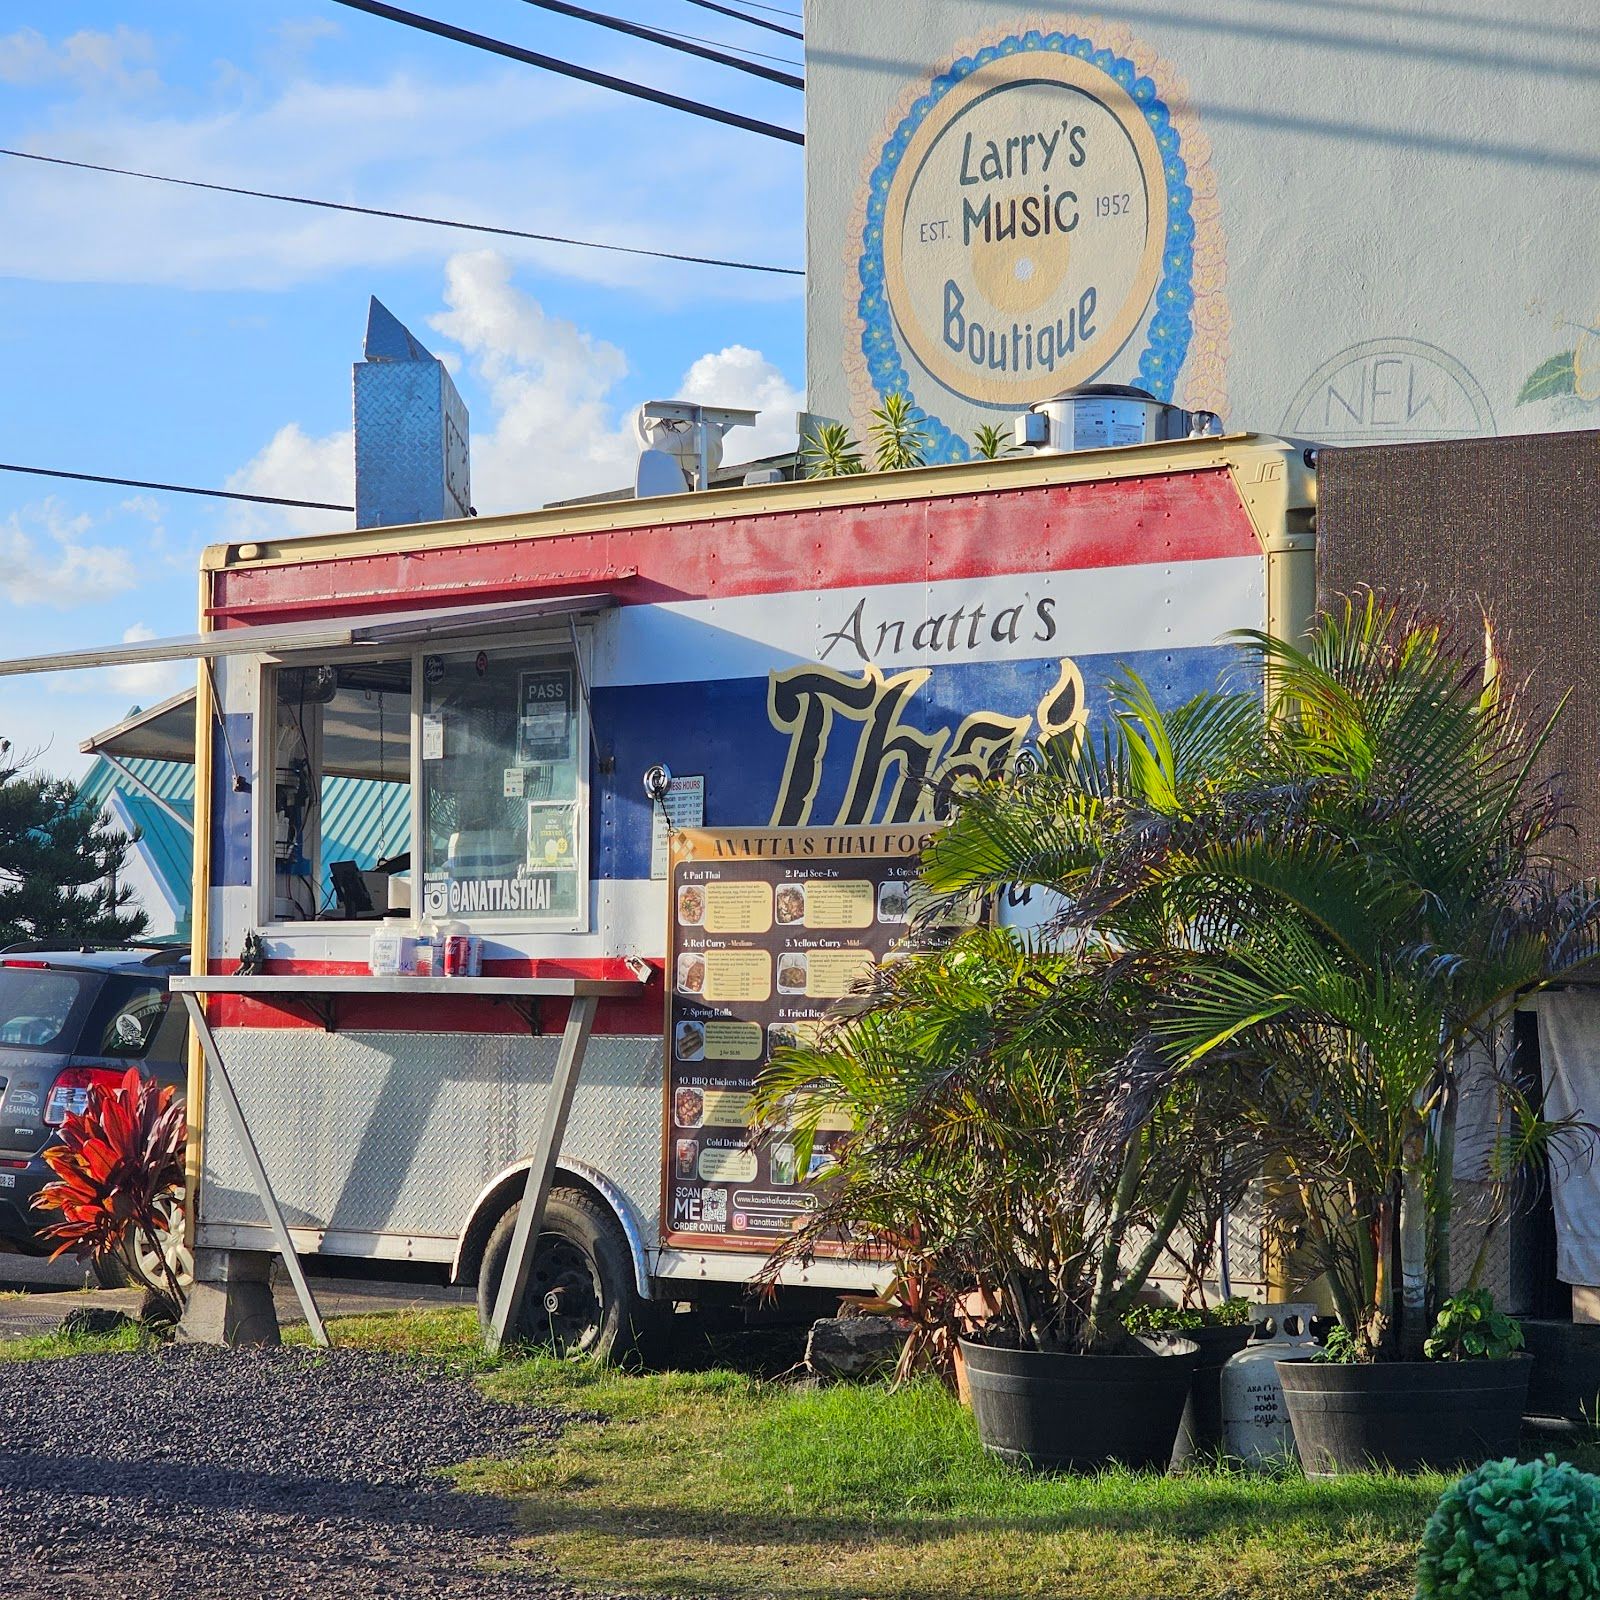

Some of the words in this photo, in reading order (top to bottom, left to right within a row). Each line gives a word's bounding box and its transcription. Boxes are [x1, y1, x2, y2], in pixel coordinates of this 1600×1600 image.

[959, 119, 1087, 187] Larry's
[1096, 193, 1131, 218] 1952
[961, 184, 1080, 246] Music
[919, 219, 952, 244] EST.
[943, 279, 1097, 373] Boutique
[821, 592, 1057, 661] Anatta's
[528, 683, 564, 698] PASS
[712, 837, 815, 857] ANATTA'S
[824, 835, 875, 854] THAI
[689, 870, 703, 880] Pad
[704, 870, 721, 880] Thai
[793, 869, 809, 878] Pad
[450, 878, 551, 913] @ANATTASTHAI
[690, 938, 705, 948] Red
[705, 938, 726, 949] Curry
[793, 938, 818, 948] Yellow
[818, 938, 842, 949] Curry
[690, 1007, 713, 1018] Spring
[713, 1007, 733, 1017] Rolls
[787, 1008, 807, 1018] Fried
[691, 1077, 709, 1087] BBQ
[709, 1077, 737, 1087] Chicken
[4, 1104, 40, 1117] SEAHAWKS
[706, 1137, 723, 1147] Cold
[723, 1138, 749, 1149] Drinks
[675, 1187, 700, 1198] SCAN
[674, 1198, 701, 1220] ME
[673, 1221, 698, 1232] ORDER
[699, 1222, 726, 1233] ONLINE
[1254, 1402, 1278, 1412] FOOD
